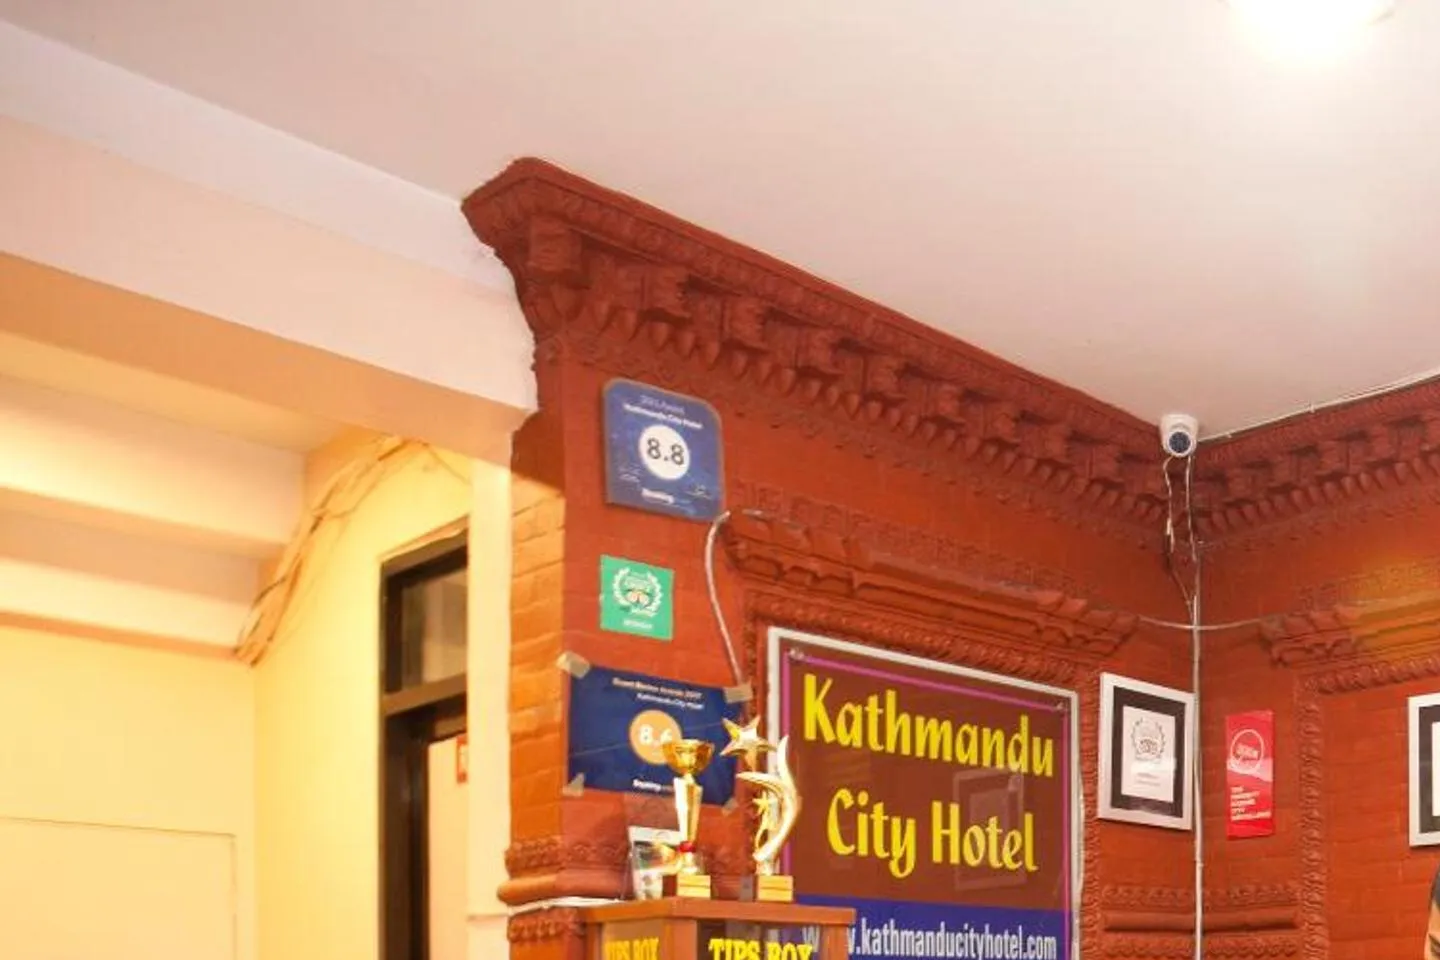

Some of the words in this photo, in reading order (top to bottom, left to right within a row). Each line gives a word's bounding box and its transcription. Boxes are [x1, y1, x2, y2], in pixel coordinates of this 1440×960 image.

[646, 437, 685, 466] 8.8
[803, 673, 1054, 777] Kathmandu
[827, 788, 917, 879] City
[932, 801, 1038, 872] Hotel
